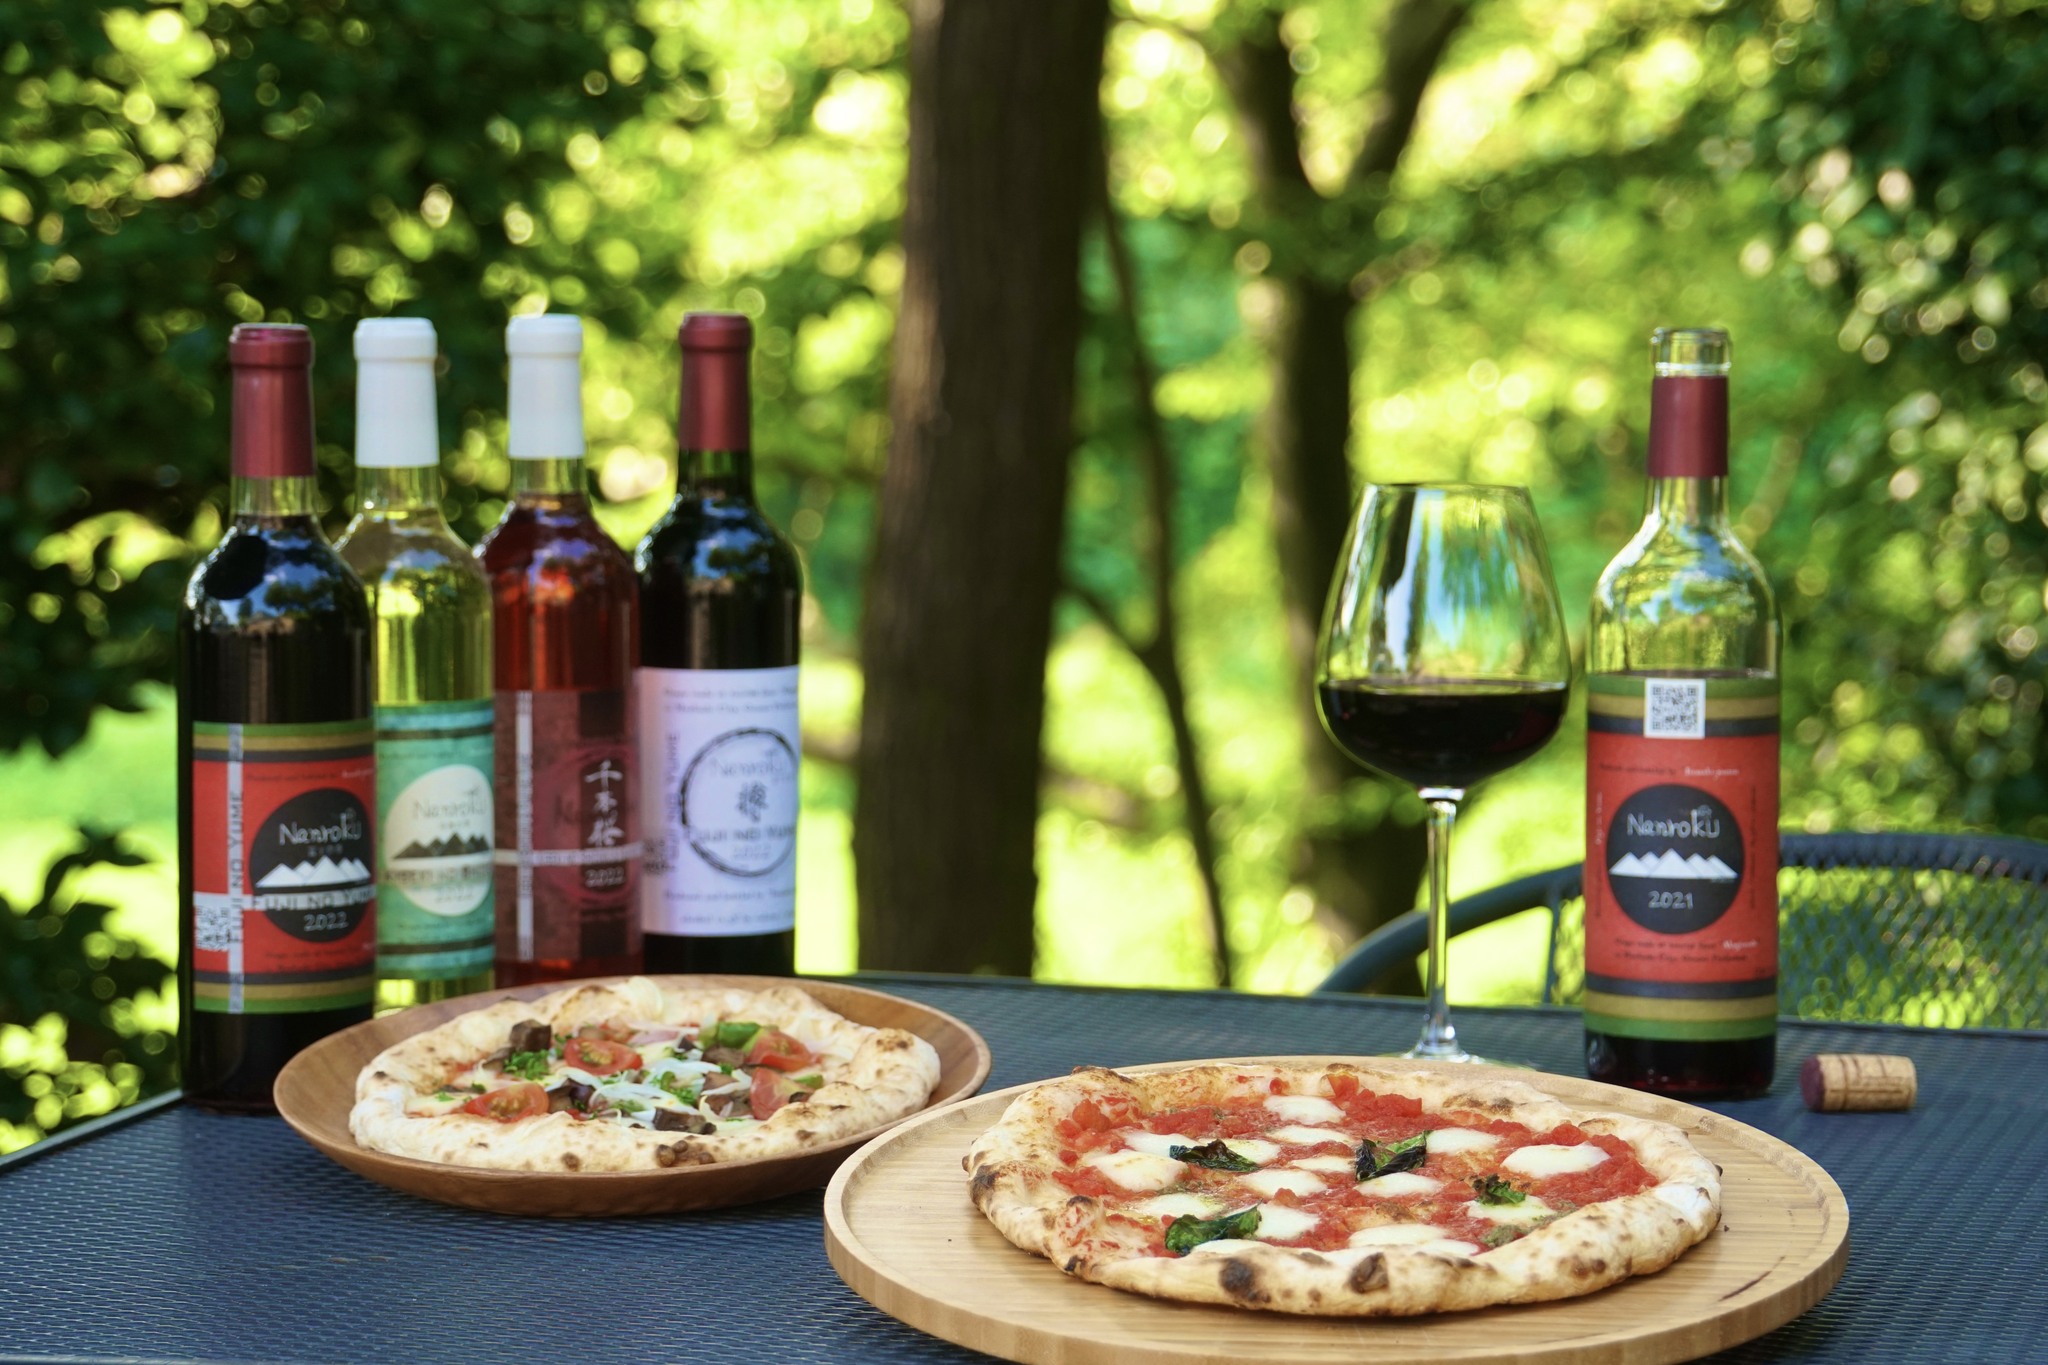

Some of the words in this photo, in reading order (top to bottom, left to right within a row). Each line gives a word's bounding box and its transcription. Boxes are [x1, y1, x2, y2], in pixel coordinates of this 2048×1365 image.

[228, 792, 243, 848] YUME
[1626, 808, 1720, 839] Nanroku
[229, 859, 243, 888] NO
[307, 892, 335, 909] NO
[1648, 890, 1694, 910] 2021
[303, 911, 350, 932] 2022
